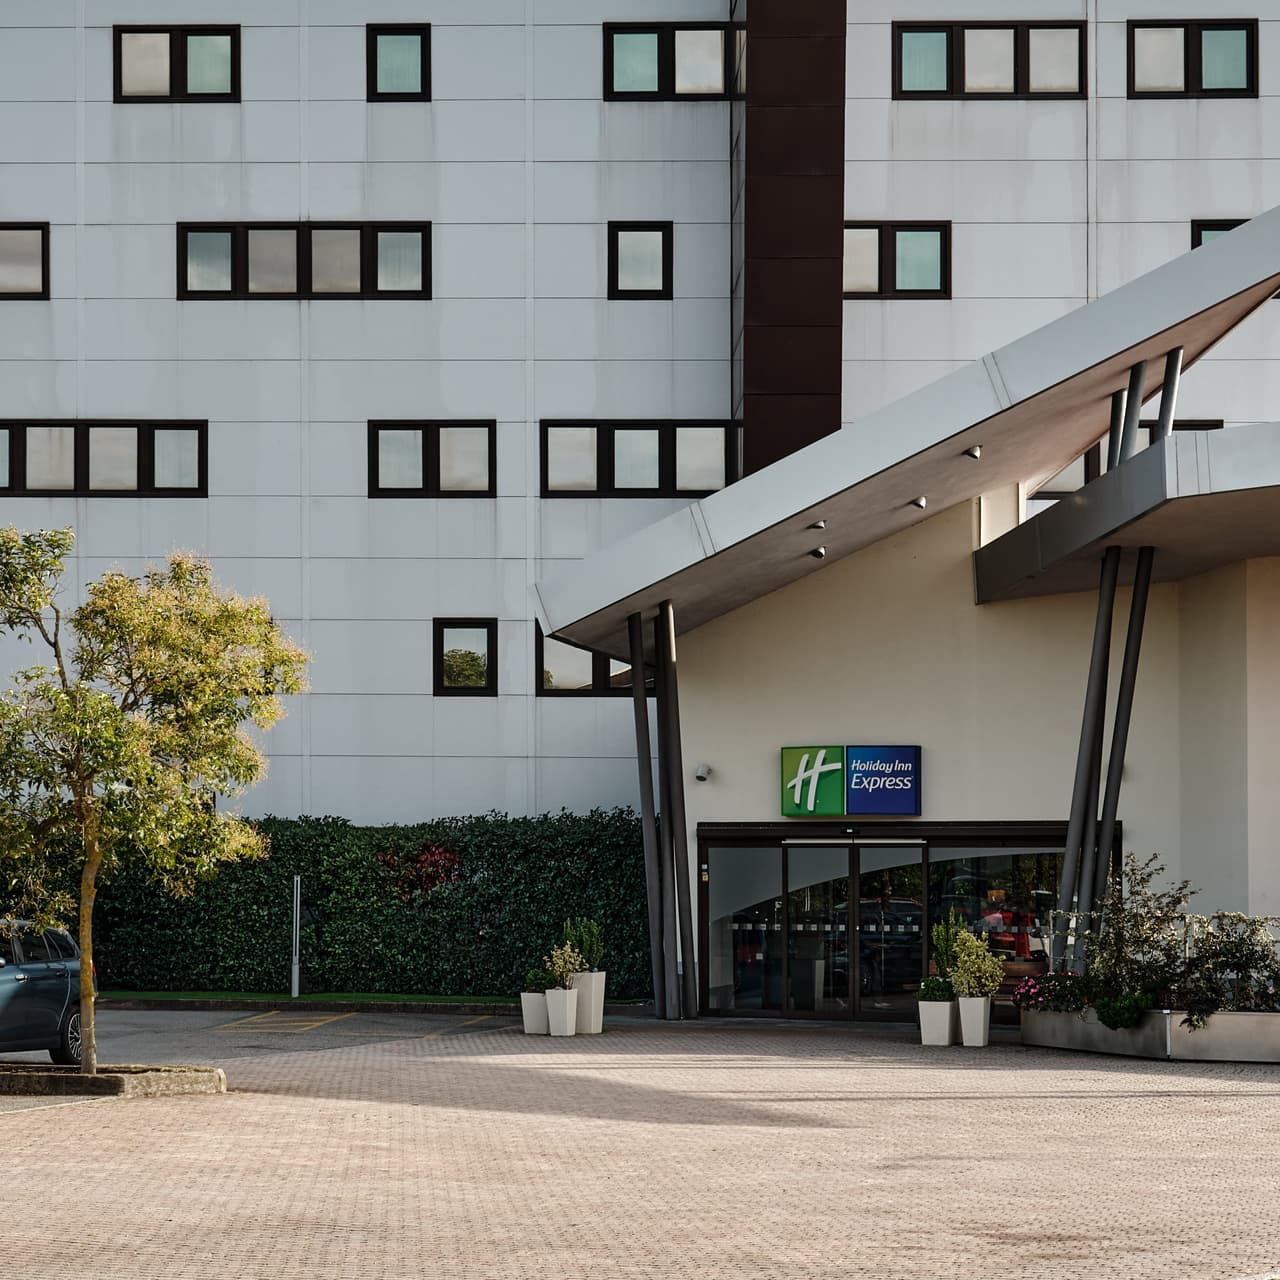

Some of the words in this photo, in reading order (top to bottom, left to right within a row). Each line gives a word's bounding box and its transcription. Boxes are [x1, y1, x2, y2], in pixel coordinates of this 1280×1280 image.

[851, 759, 894, 774] Holiday
[894, 759, 912, 771] Inn
[851, 773, 913, 793] Express
